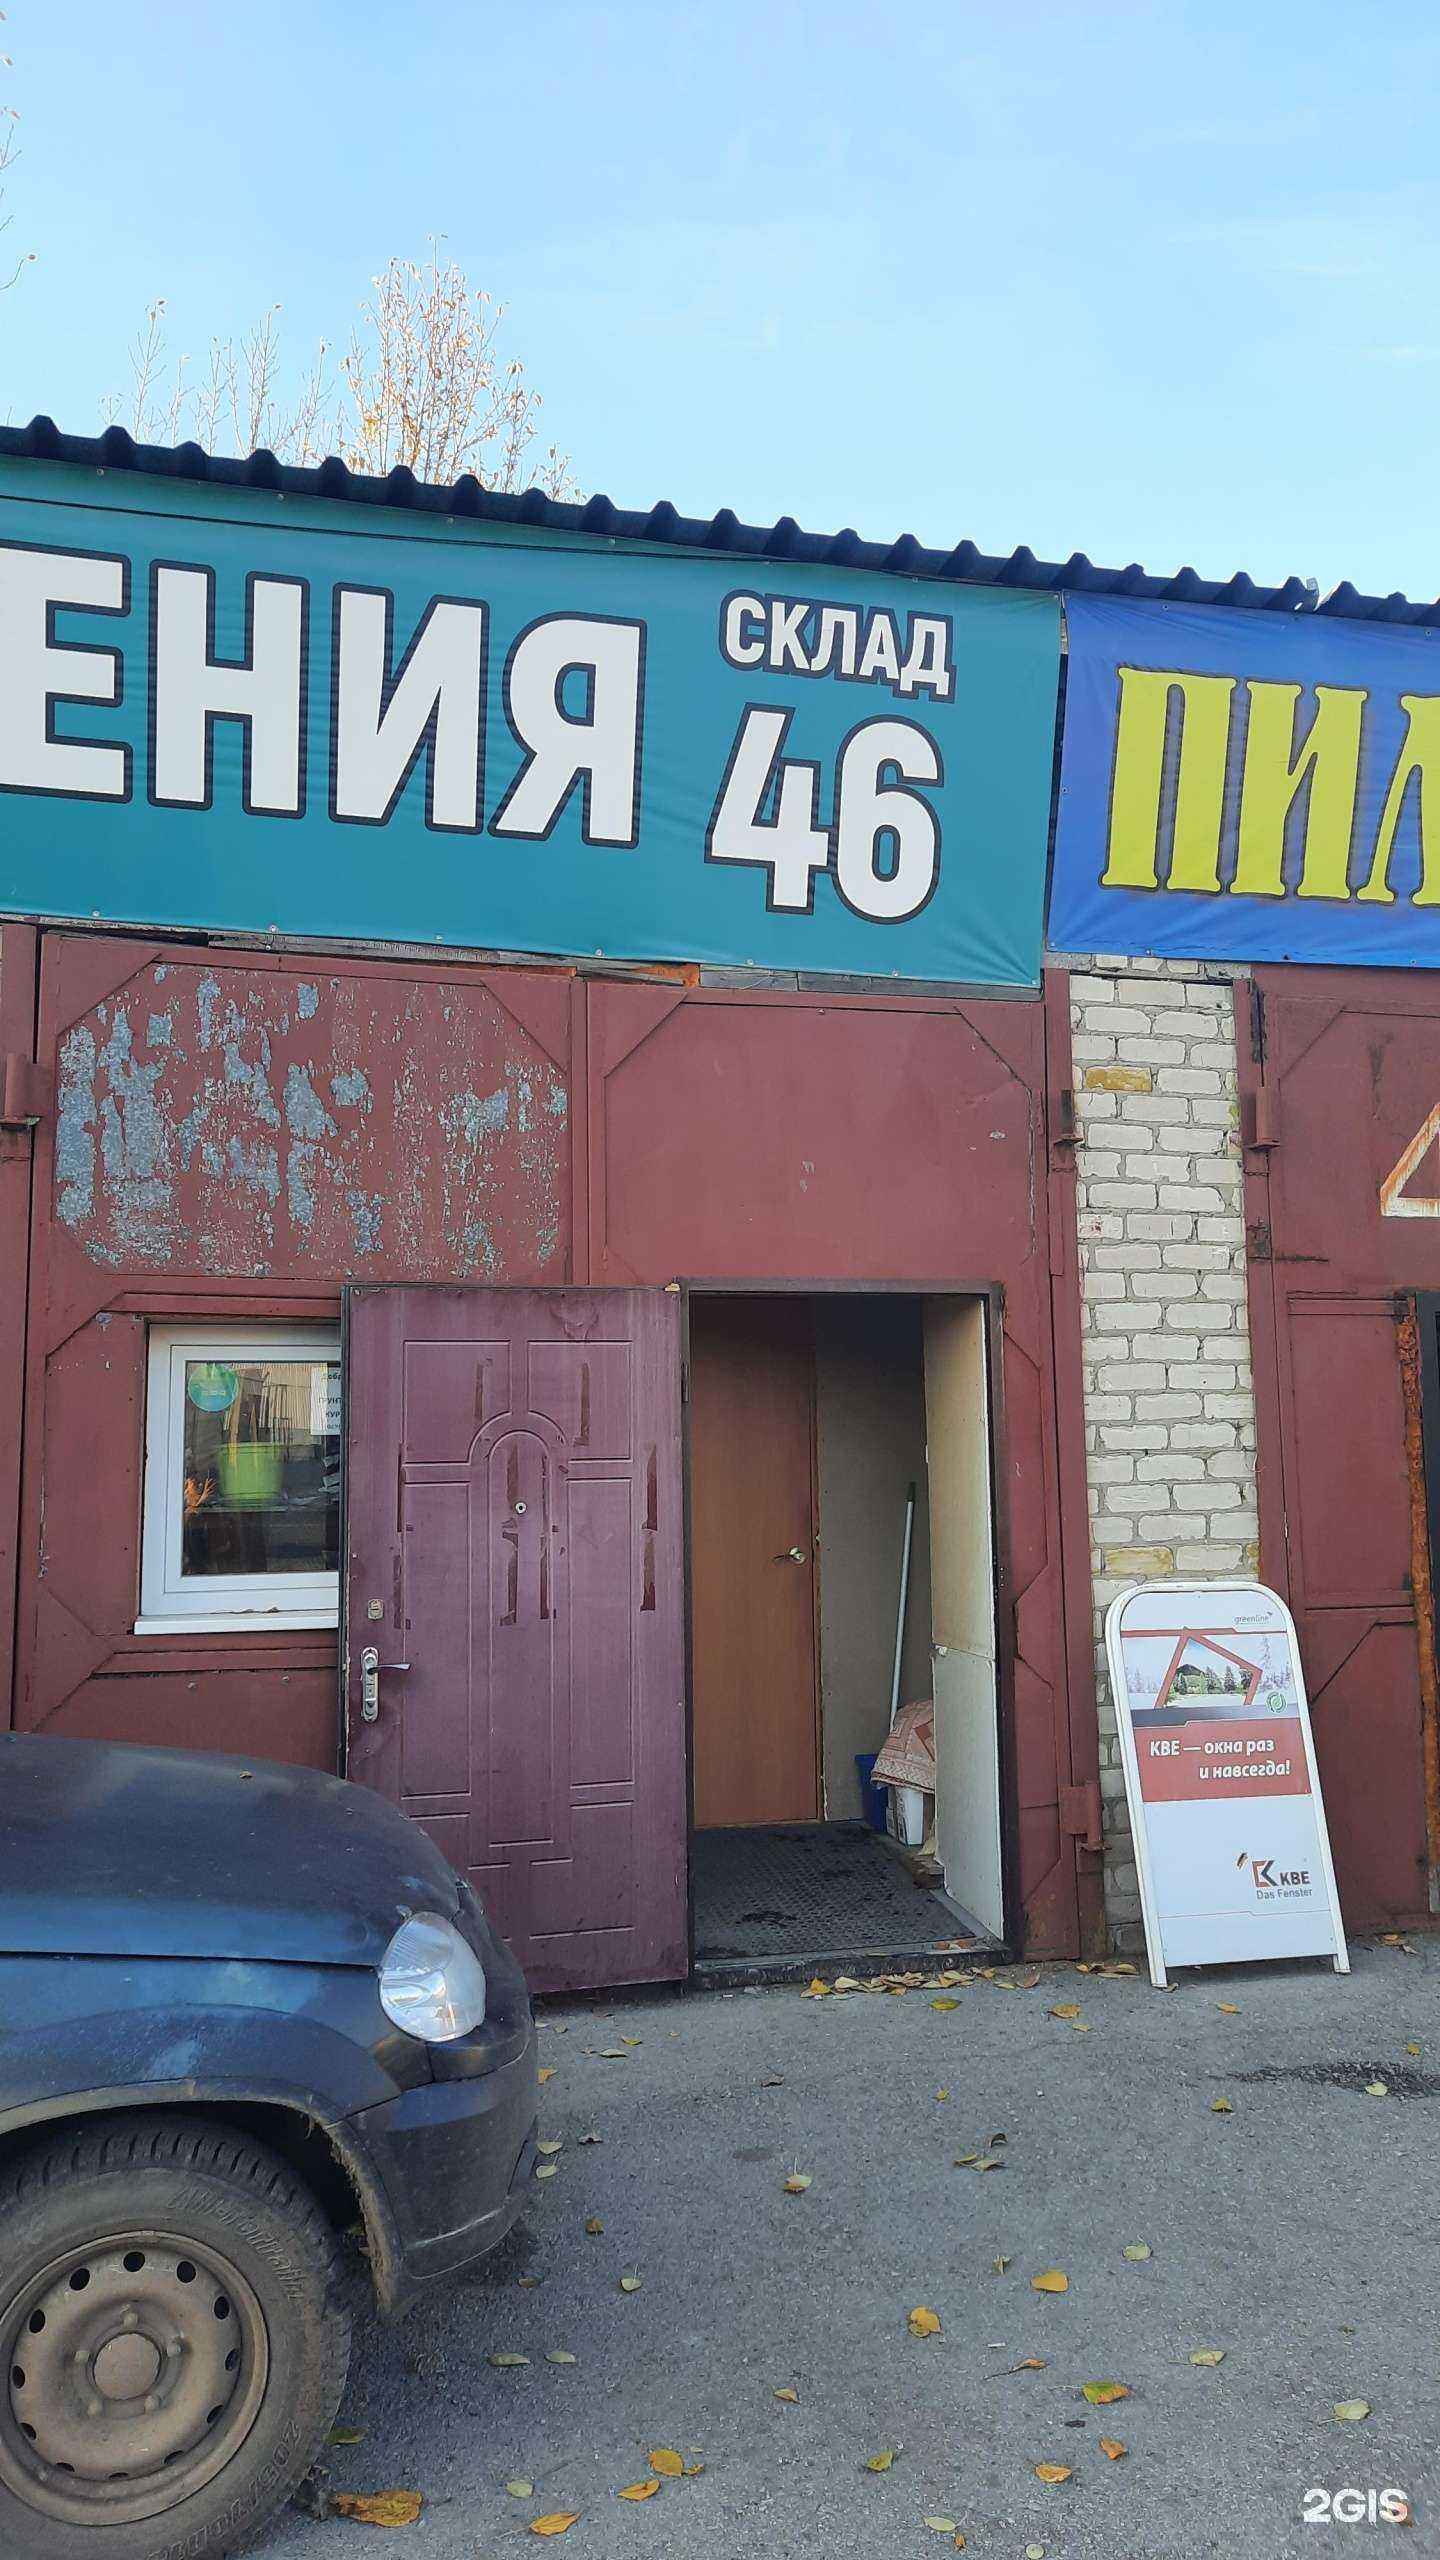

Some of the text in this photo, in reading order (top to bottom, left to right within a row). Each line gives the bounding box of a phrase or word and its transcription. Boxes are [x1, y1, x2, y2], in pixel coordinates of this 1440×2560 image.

[721, 590, 955, 702] СКЛАД
[0, 539, 646, 848] ЕНИЯ
[705, 702, 944, 925] 46
[1204, 1741, 1243, 1755] окна
[1246, 1740, 1275, 1756] раз
[1199, 1759, 1291, 1779] и навсегда!
[1280, 1871, 1311, 1886] KBE
[1256, 1887, 1313, 1900] Das Fenster
